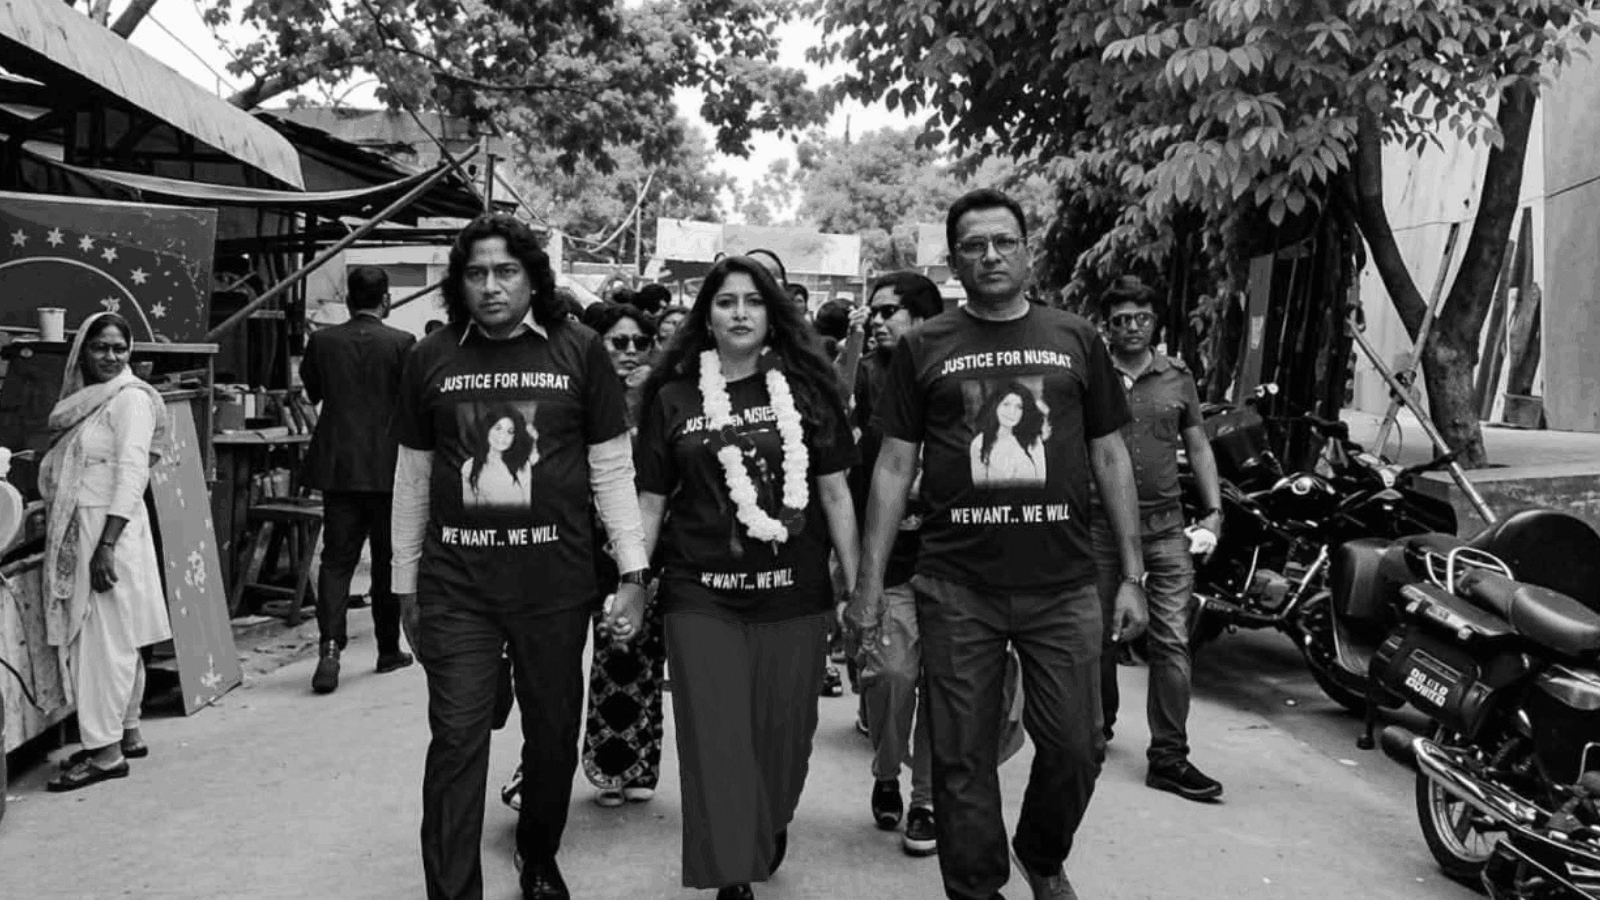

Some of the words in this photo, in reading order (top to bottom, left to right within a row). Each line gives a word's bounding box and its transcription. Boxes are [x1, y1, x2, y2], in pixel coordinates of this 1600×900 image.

[941, 352, 994, 375] JUSTICE
[997, 350, 1022, 366] FOR
[1023, 349, 1072, 369] NUSRAT
[440, 373, 492, 393] JUSTICE
[493, 372, 519, 389] FOR
[521, 371, 570, 390] NUSRAT
[950, 508, 970, 524] WE
[970, 506, 1019, 524] WANT..
[1022, 504, 1043, 522] WE
[1046, 503, 1070, 522] WILL
[442, 525, 459, 545] WE
[459, 528, 506, 546] WANT..
[507, 528, 528, 546] WE
[531, 524, 560, 544] WILL
[701, 572, 714, 588] WE
[756, 571, 772, 589] WE
[773, 567, 795, 588] WILL
